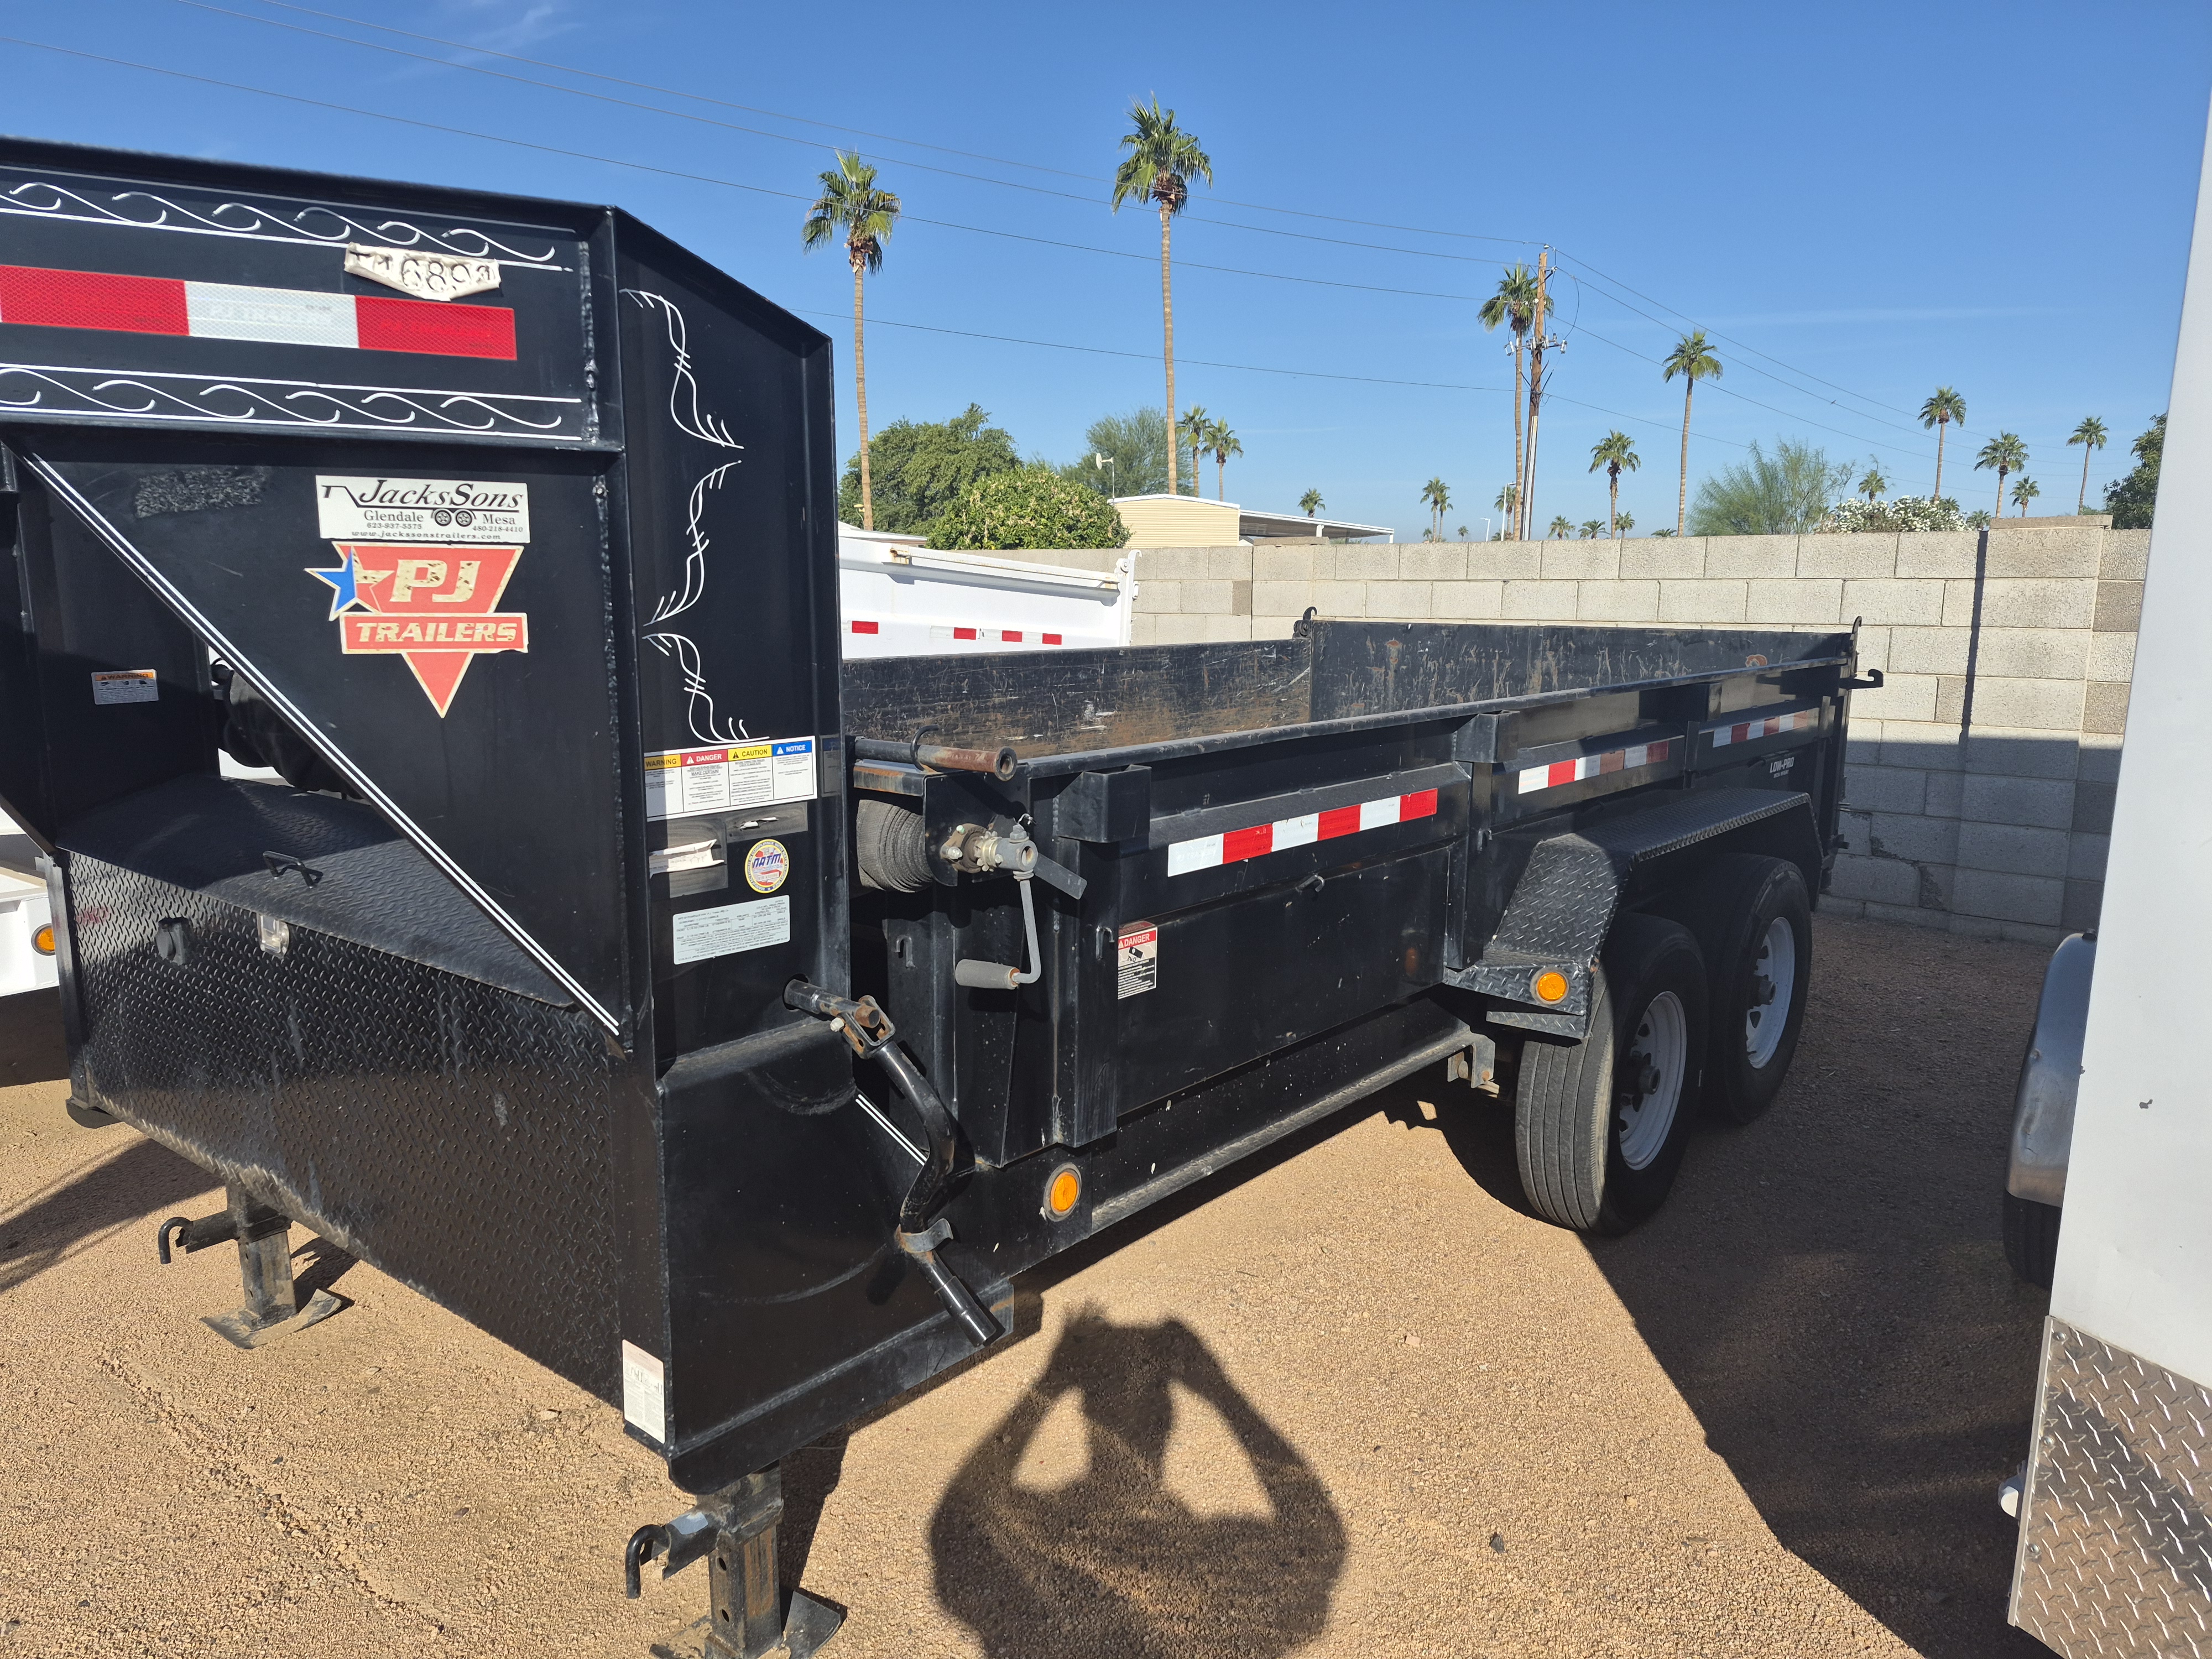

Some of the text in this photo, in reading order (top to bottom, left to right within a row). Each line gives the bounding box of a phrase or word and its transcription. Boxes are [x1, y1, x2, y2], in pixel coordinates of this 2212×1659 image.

[359, 479, 523, 508] JacksSons
[363, 510, 424, 523] Glendale
[482, 514, 516, 525] Mesa
[351, 530, 501, 540] www.jackssonstrailers.com
[389, 559, 482, 602] PJ
[356, 622, 518, 643] TRAILERS
[742, 748, 768, 757] CAUTION
[786, 744, 806, 753] NOTICE
[645, 758, 677, 767] WARNING
[696, 754, 722, 762] DANGER
[1124, 933, 1150, 947] DANGER
